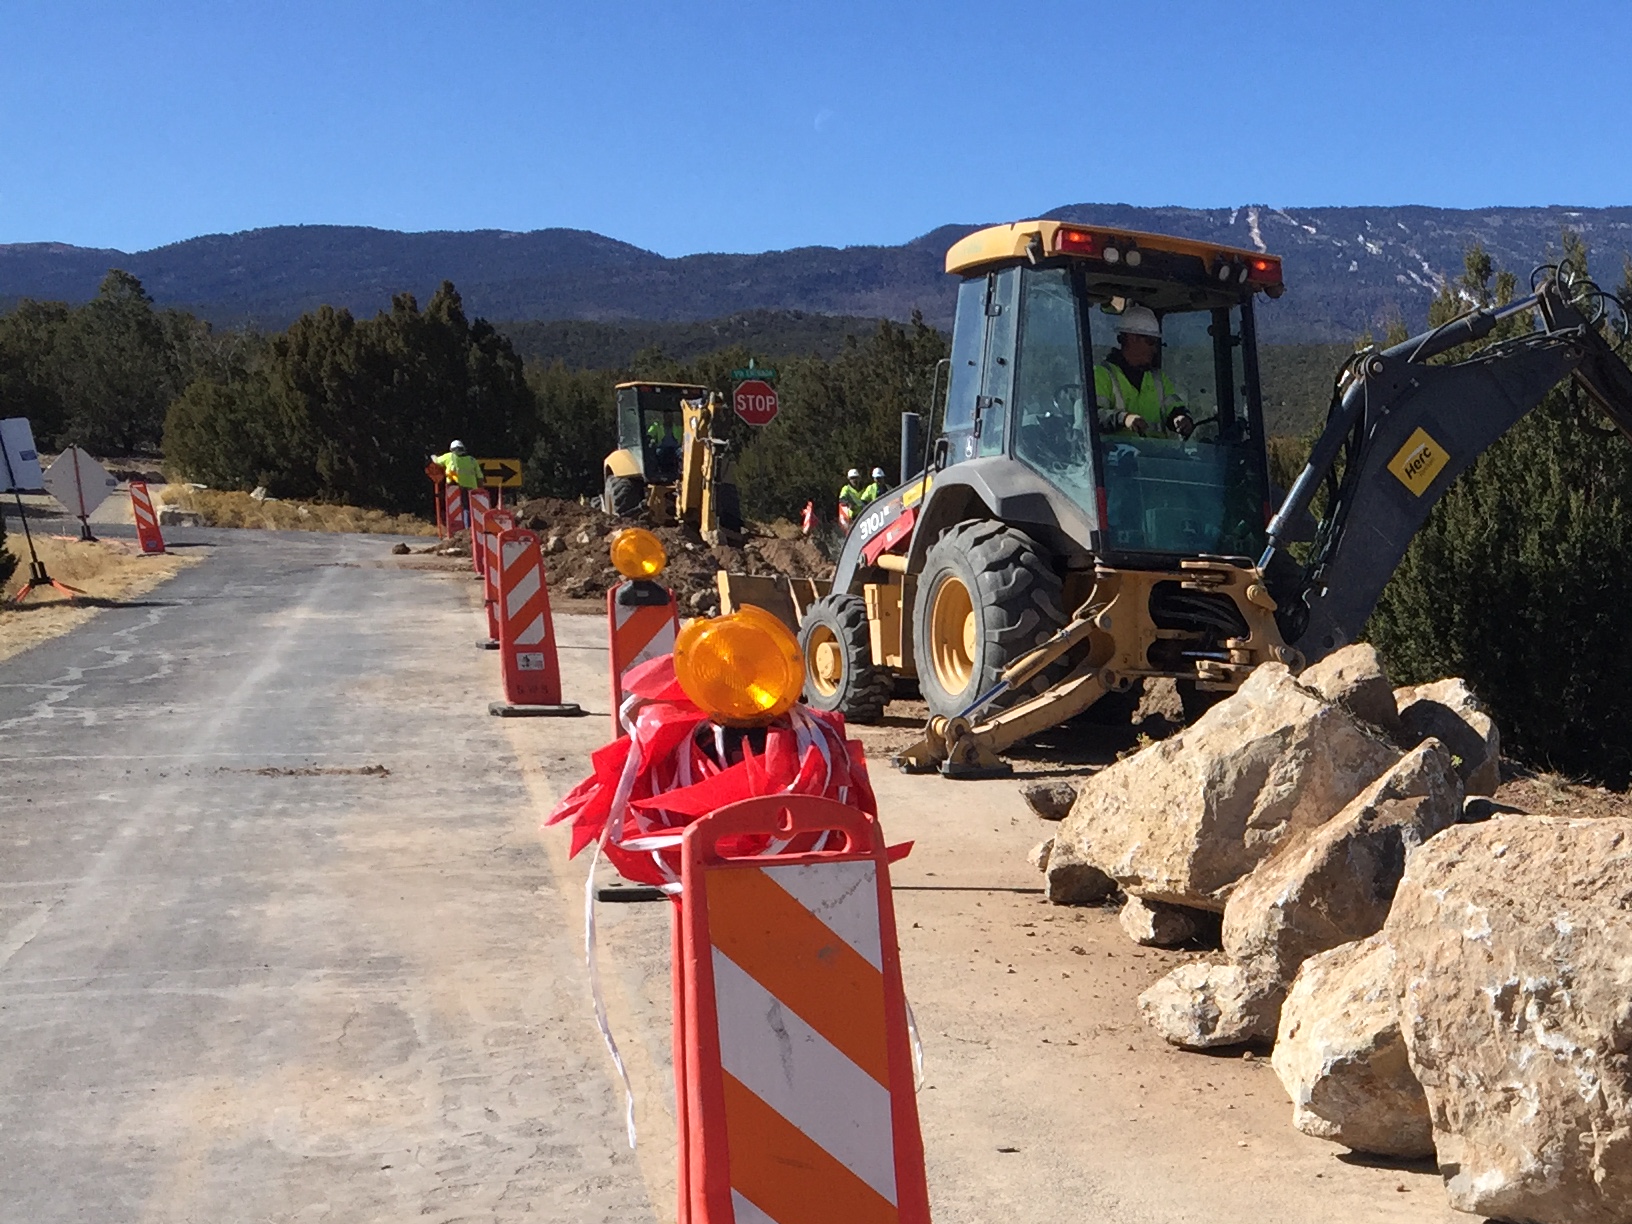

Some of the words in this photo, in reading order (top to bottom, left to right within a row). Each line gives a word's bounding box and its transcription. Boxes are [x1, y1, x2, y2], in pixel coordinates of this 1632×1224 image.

[737, 394, 776, 412] STOP
[1404, 446, 1432, 480] Herc
[859, 510, 885, 540] 310J
